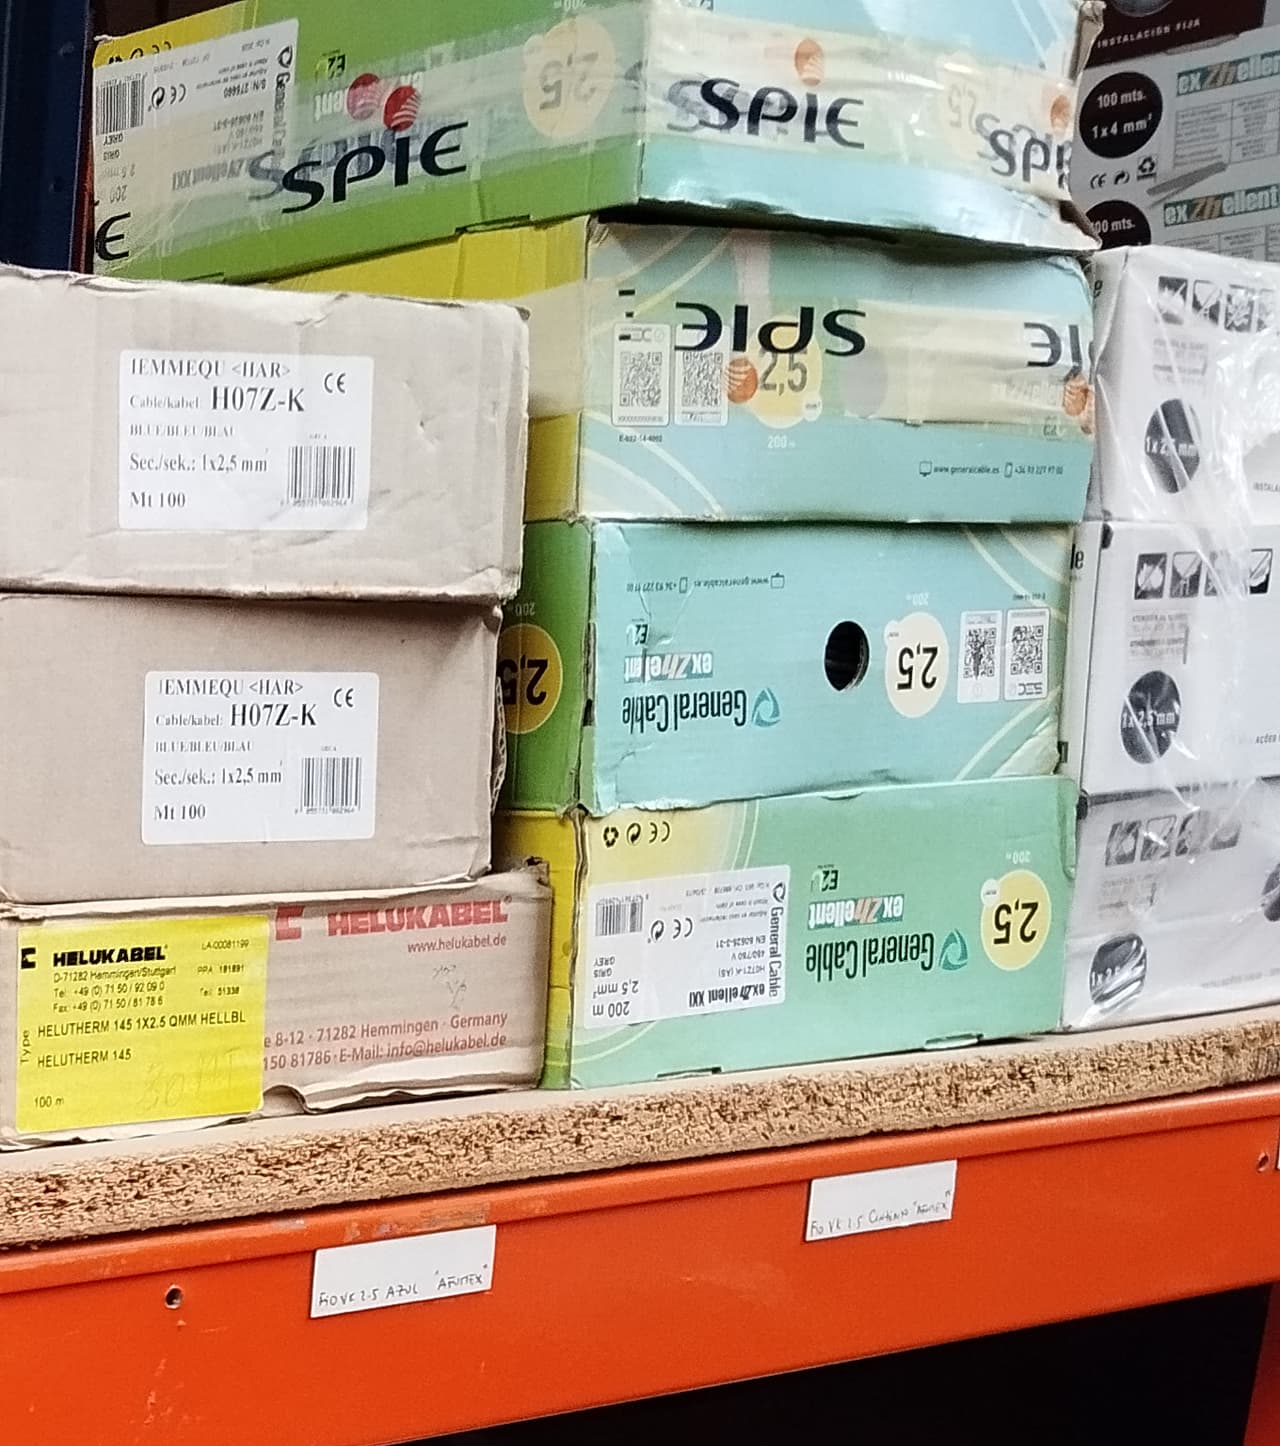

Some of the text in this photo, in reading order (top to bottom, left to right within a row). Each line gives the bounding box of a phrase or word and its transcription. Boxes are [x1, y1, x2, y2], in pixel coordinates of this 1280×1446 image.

[696, 78, 864, 149] SPIE
[1097, 91, 1118, 109] 100
[281, 121, 470, 215] SPIE
[674, 302, 866, 357] SPIE
[211, 386, 305, 412] H07Z-K
[158, 492, 186, 508] 100
[897, 643, 938, 691] 2,5
[230, 703, 318, 727] H07Z-K
[622, 688, 747, 735] General Cable
[180, 804, 206, 820] 100
[993, 899, 1039, 944] 2,5
[407, 934, 507, 953] www.helukabel.de
[806, 933, 935, 982] General Cable
[621, 979, 638, 995] 2,5
[608, 1001, 630, 1018] 200
[38, 1020, 110, 1038] HELUTHERM
[113, 1018, 133, 1031] 145
[200, 1010, 246, 1025] HELLBL
[275, 1011, 508, 1046] 8-12 71282 Hemmingen Germany
[37, 1048, 132, 1068] HELUTHERM 145
[290, 1032, 507, 1068] 81786 E-Mail: info@helukabel.de
